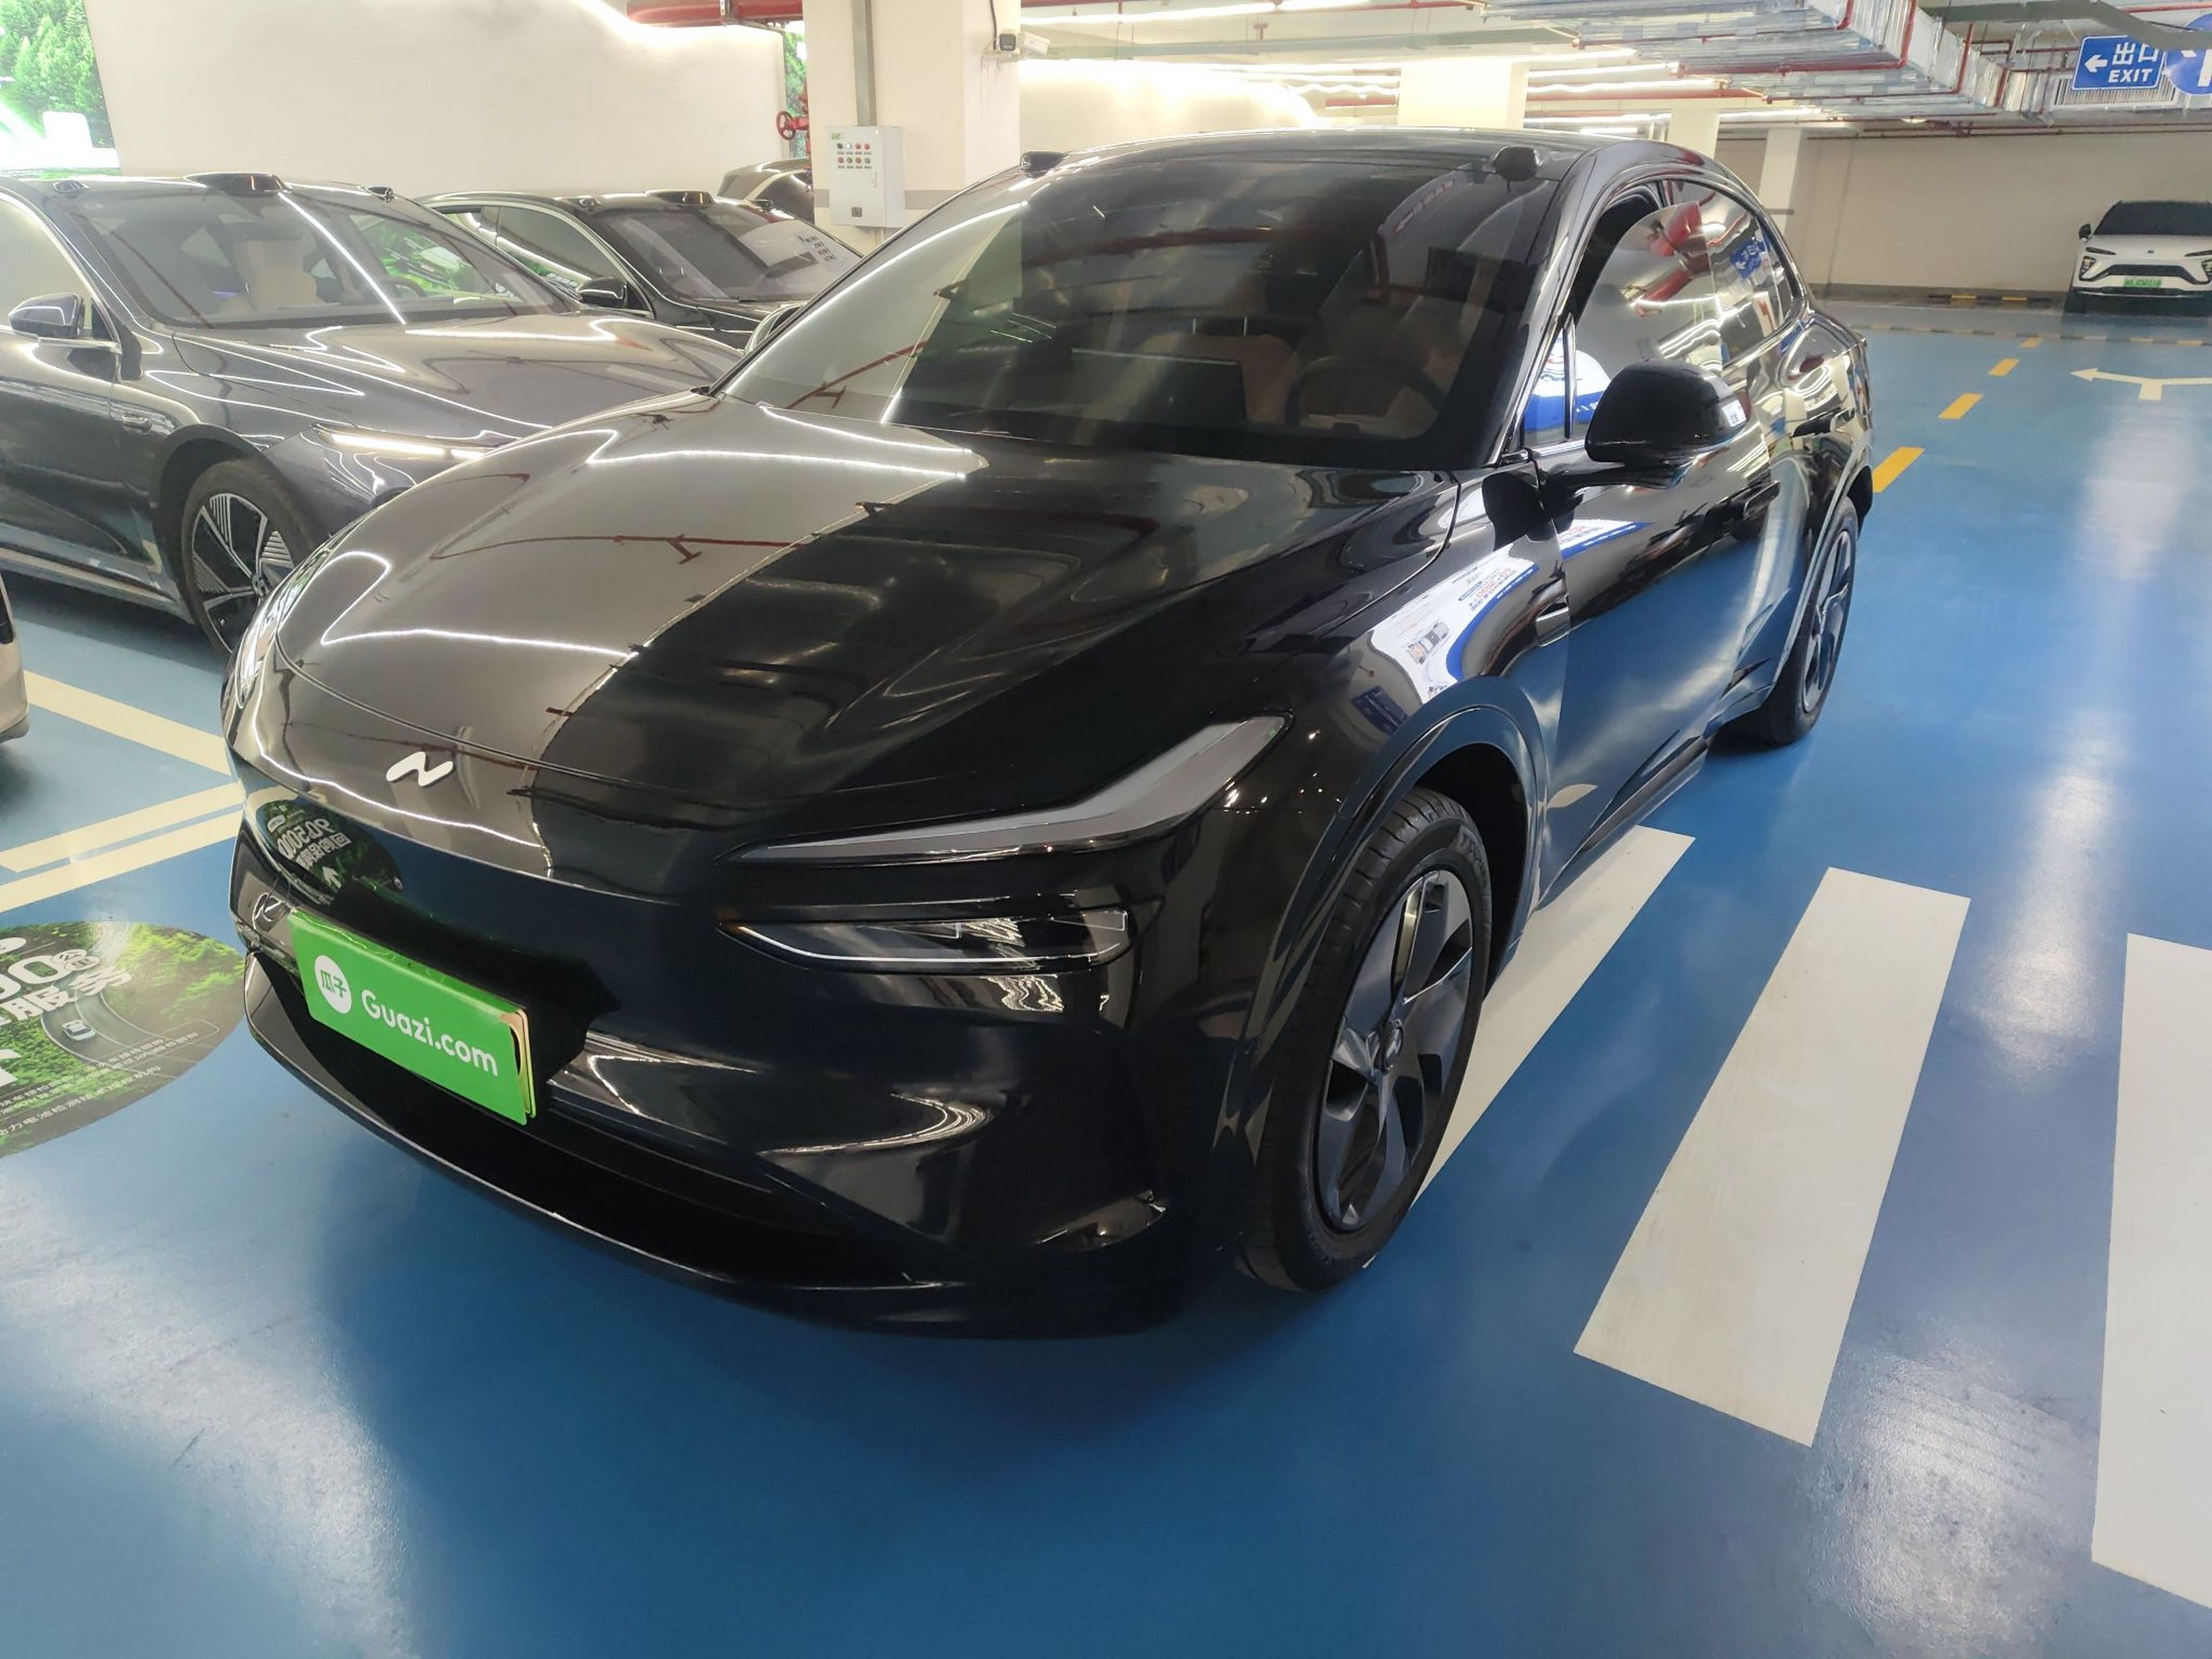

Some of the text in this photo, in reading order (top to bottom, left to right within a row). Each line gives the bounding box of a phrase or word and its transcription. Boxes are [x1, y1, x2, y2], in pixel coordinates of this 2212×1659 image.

[2112, 41, 2160, 65] 出口
[2108, 69, 2153, 83] EXIT
[320, 969, 498, 1077] 瓜子 Guazi.com
